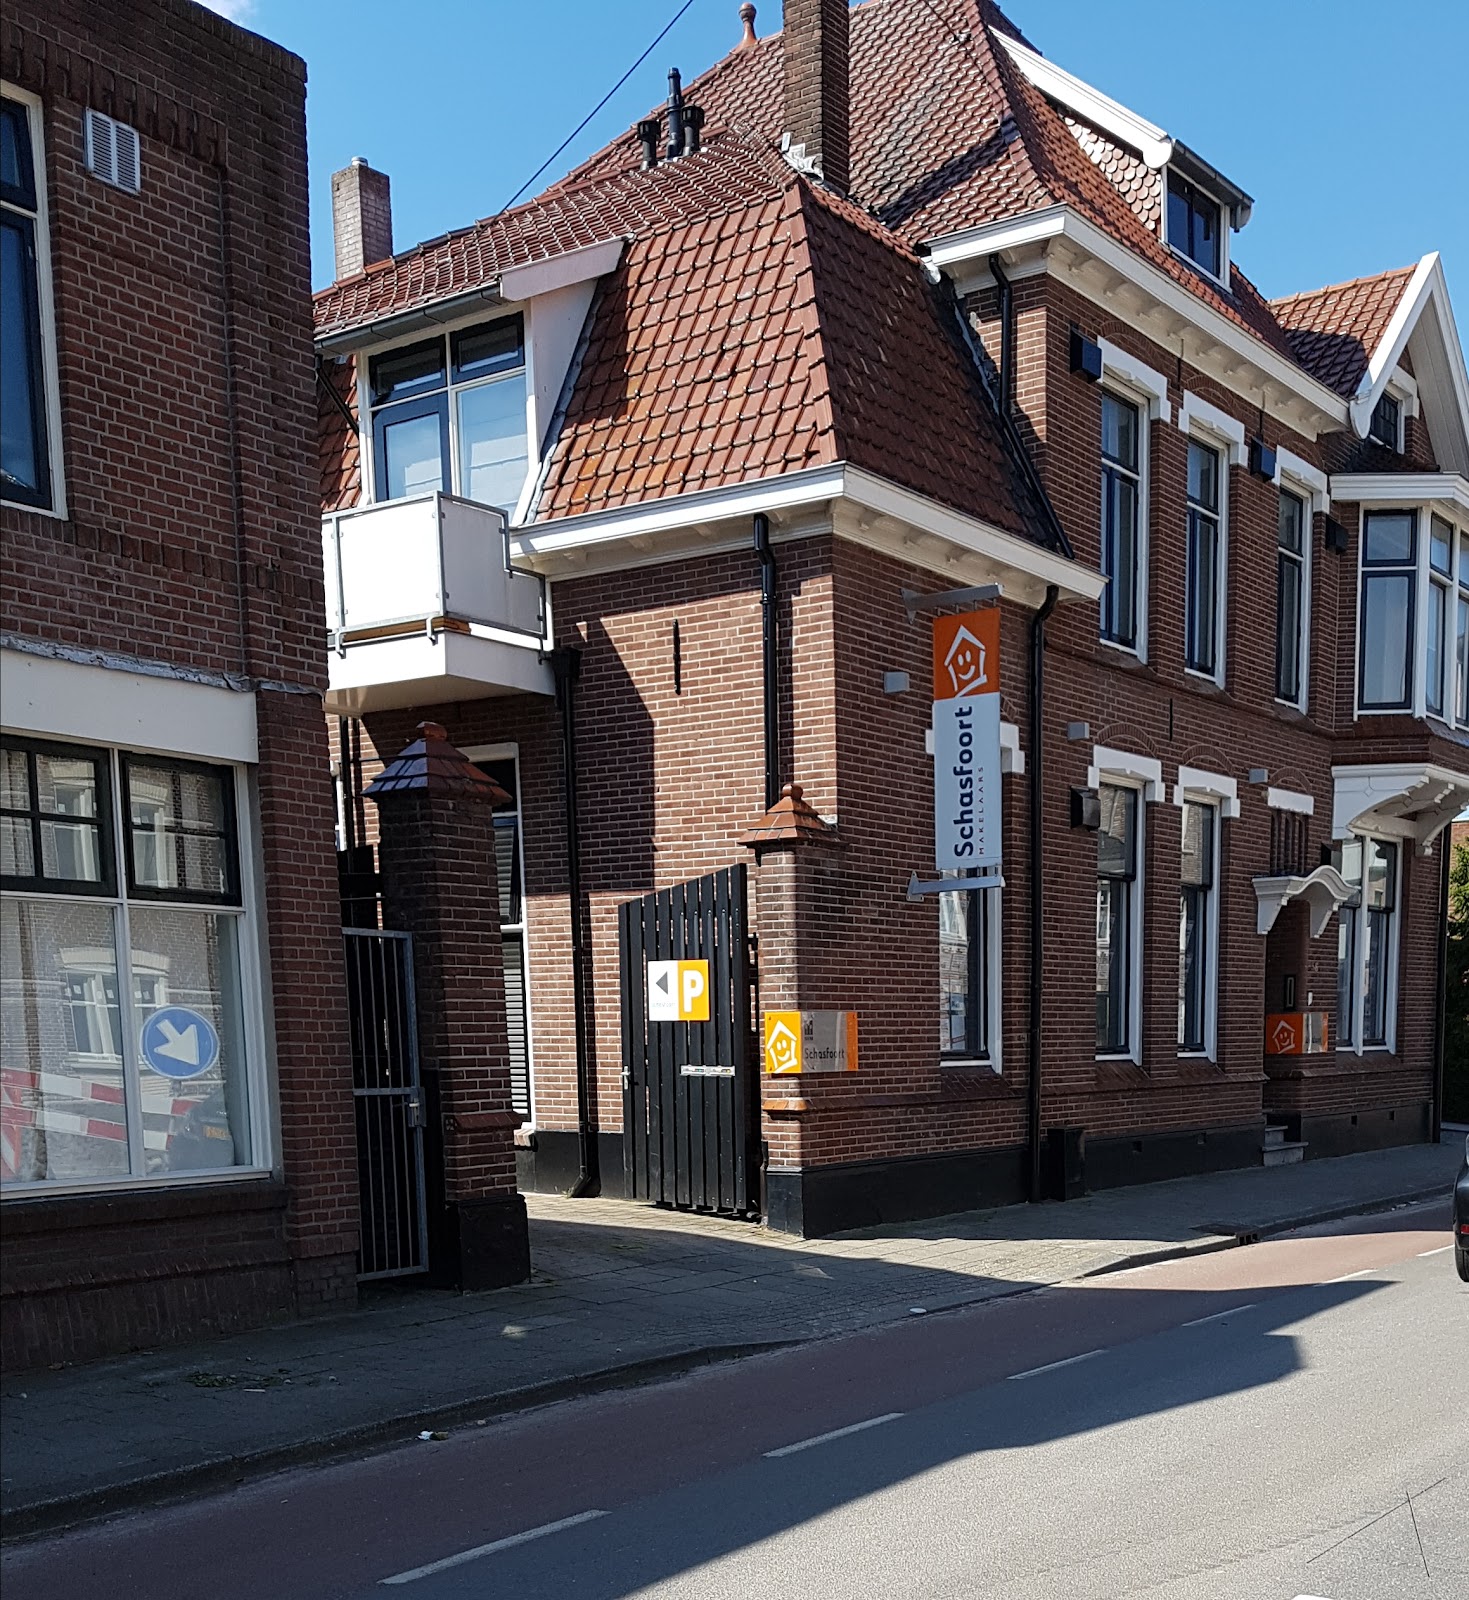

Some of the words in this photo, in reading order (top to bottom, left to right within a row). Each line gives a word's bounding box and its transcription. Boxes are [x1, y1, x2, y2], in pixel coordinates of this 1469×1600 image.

[953, 705, 974, 857] Schasfoort
[683, 969, 705, 1013] P
[804, 1047, 845, 1059] Schasfoort
